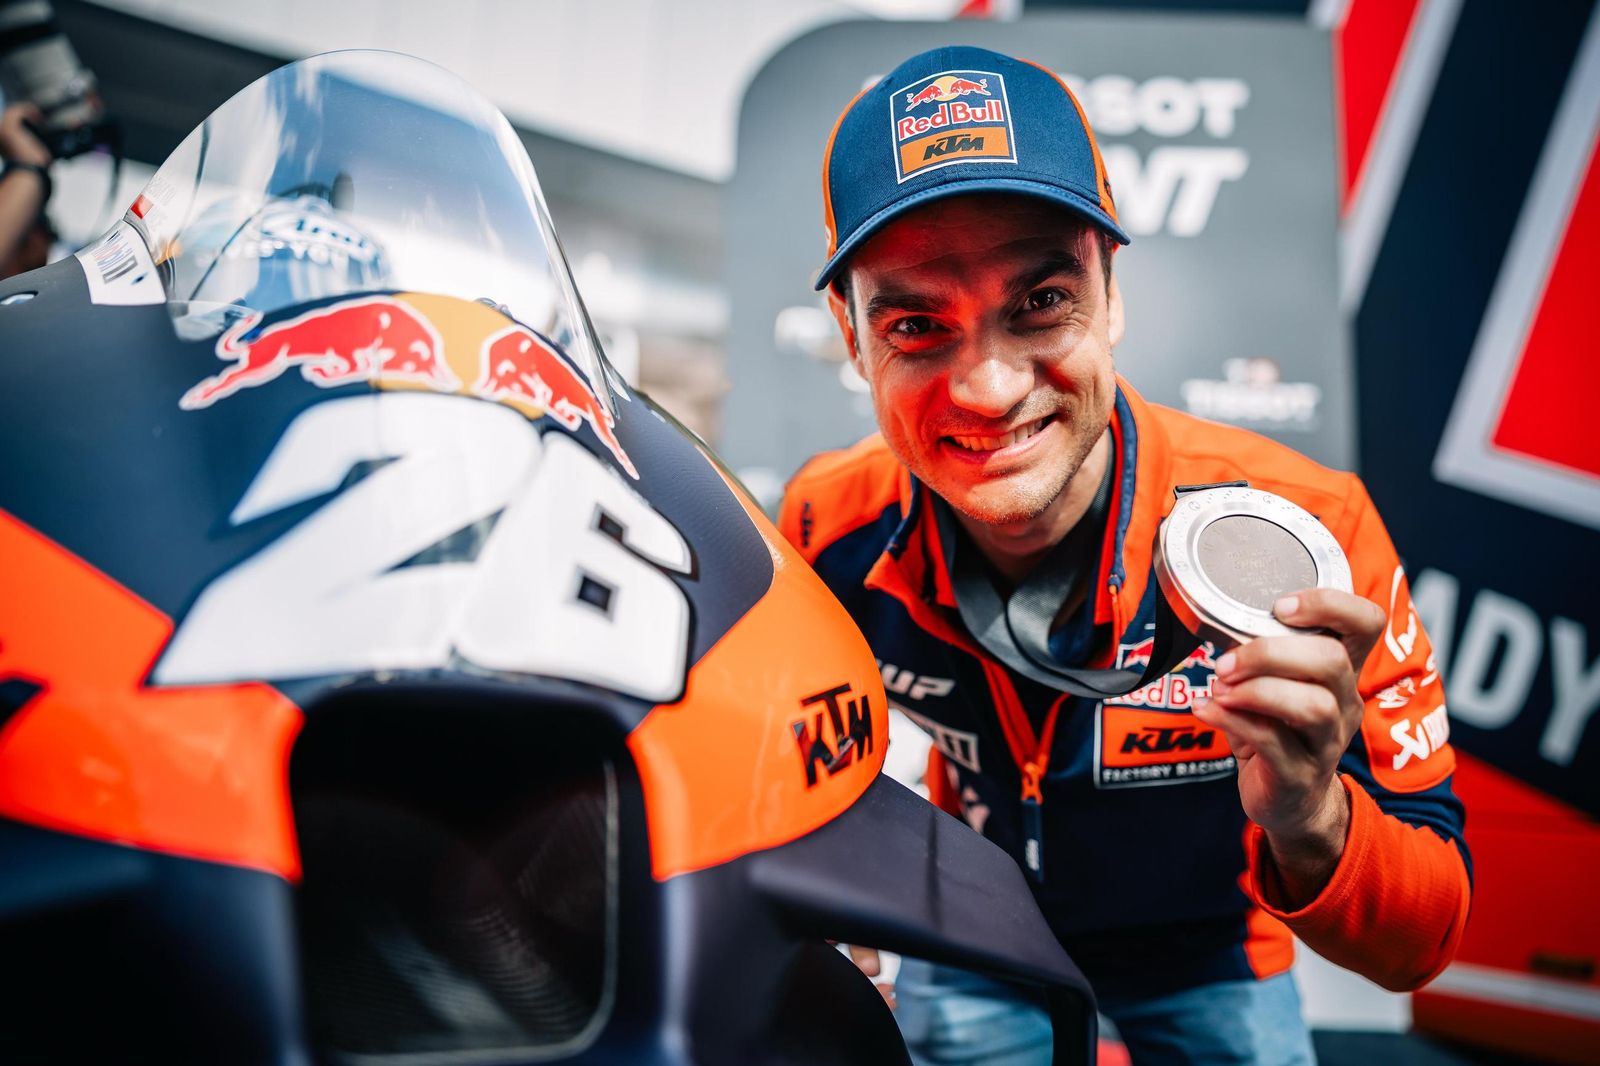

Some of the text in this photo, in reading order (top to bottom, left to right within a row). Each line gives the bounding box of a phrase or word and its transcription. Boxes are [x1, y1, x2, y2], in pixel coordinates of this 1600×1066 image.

[898, 99, 1004, 141] Red Bull
[922, 133, 985, 161] KTM
[152, 391, 693, 703] 26
[1103, 676, 1167, 708] ed
[792, 682, 875, 787] KTM
[1119, 726, 1216, 754] KTM
[1102, 756, 1236, 783] FACTORY RACING
